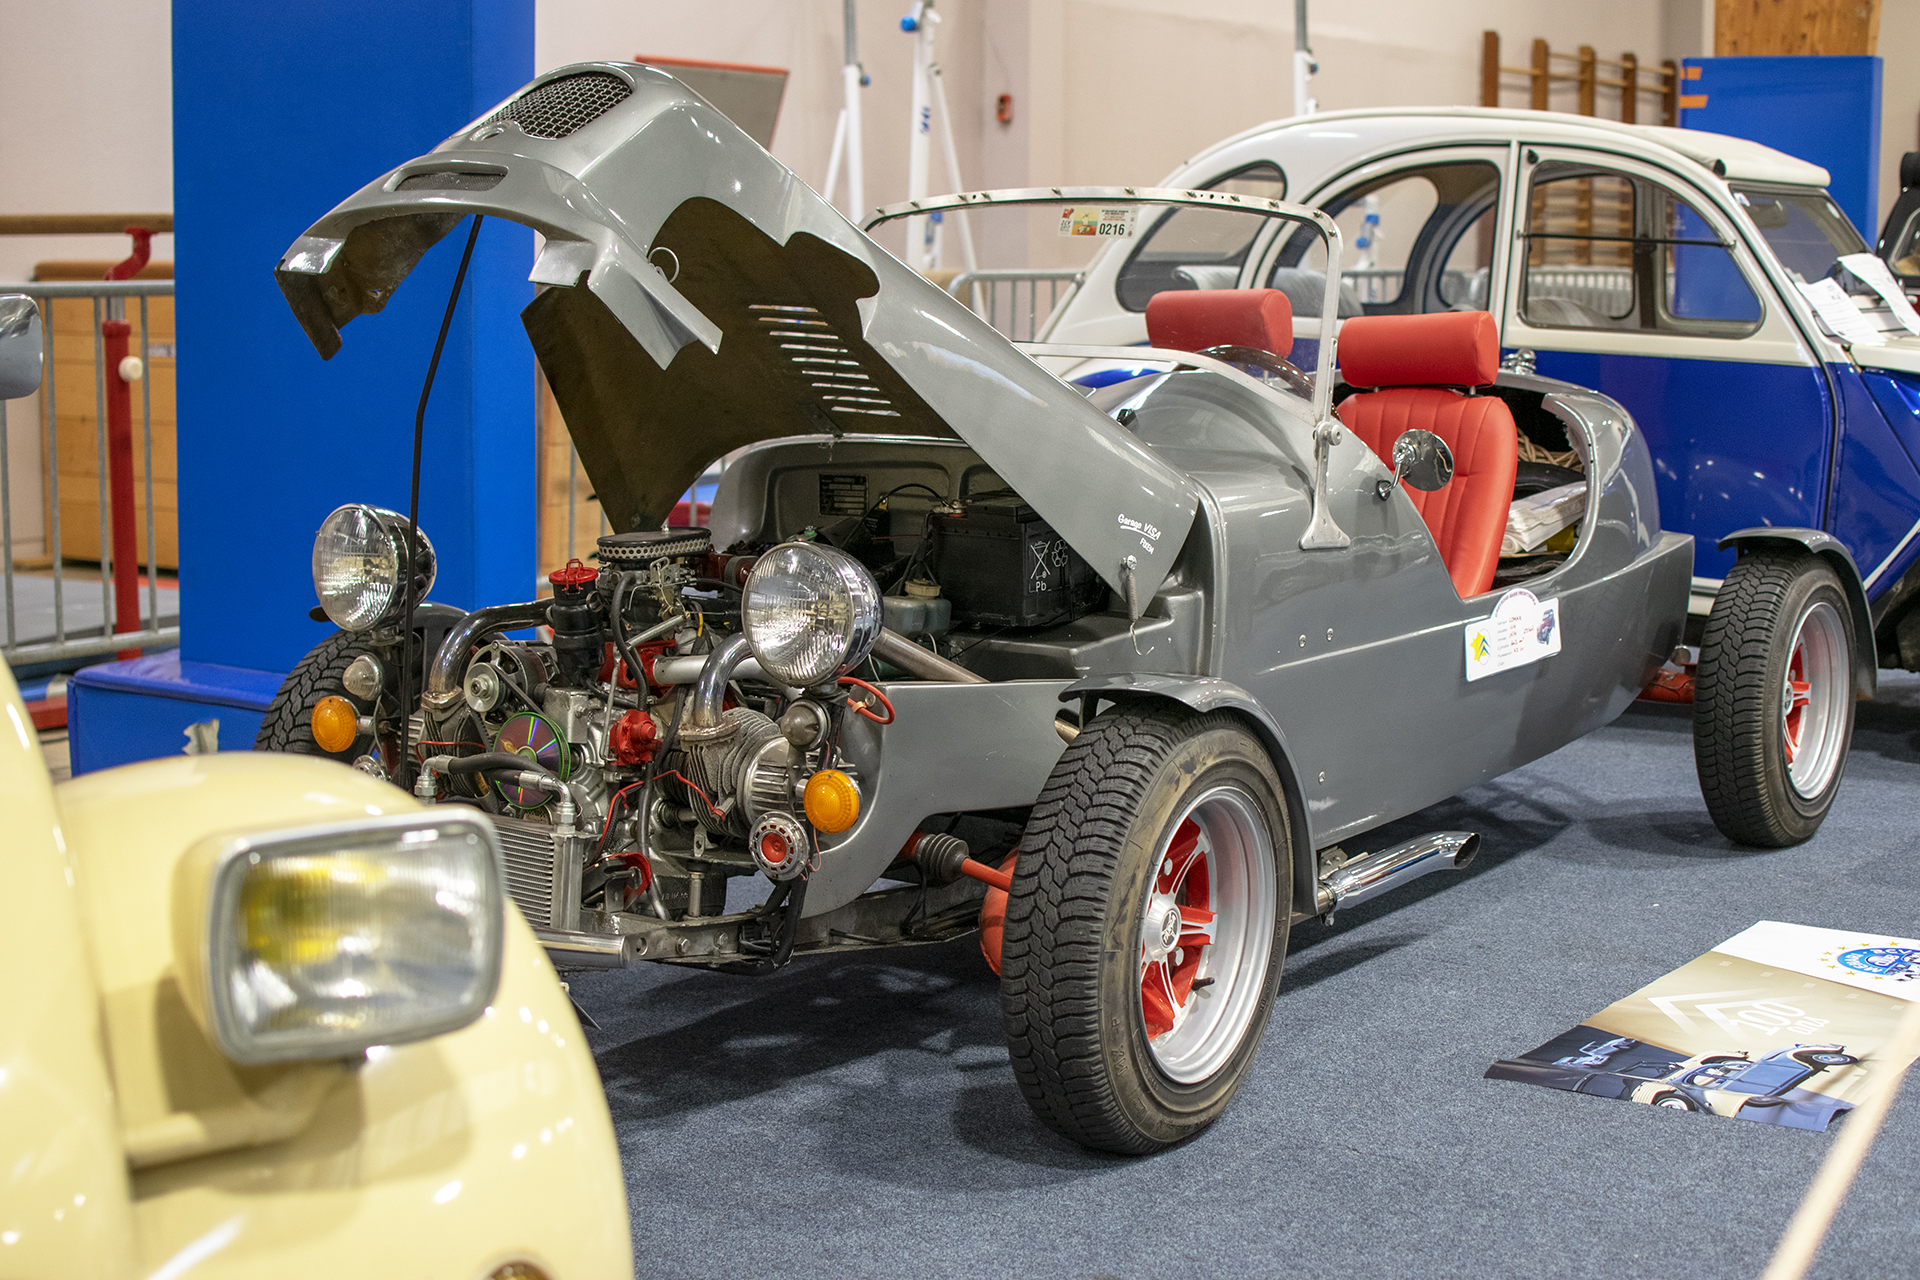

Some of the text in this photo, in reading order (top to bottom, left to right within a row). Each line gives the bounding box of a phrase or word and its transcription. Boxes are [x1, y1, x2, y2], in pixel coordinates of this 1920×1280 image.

[1099, 223, 1125, 236] 0216
[1117, 513, 1162, 540] Garage VISA
[1035, 580, 1047, 592] Pb
[1729, 1001, 1806, 1036] 100
[1786, 1016, 1831, 1036] ans
